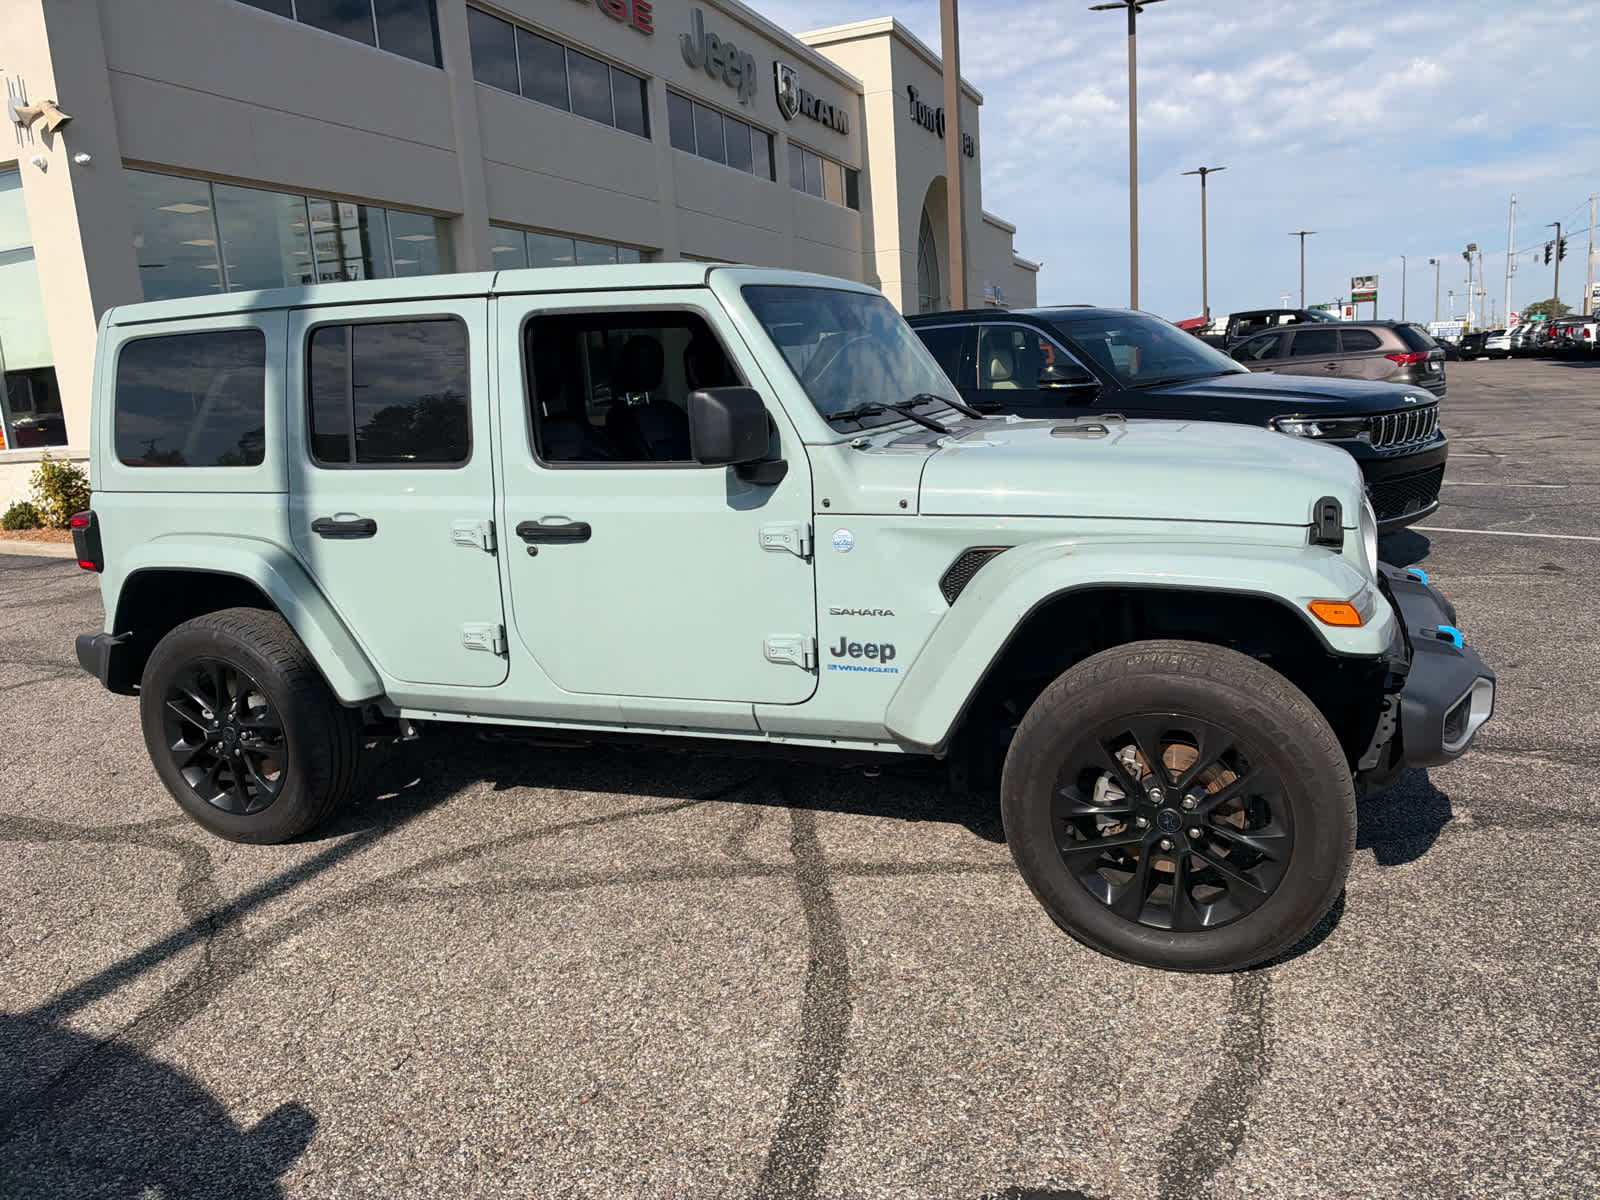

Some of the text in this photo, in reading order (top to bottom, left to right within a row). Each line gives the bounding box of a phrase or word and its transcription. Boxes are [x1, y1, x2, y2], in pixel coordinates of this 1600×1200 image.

[679, 7, 757, 105] Jeep
[798, 87, 849, 135] RAM
[906, 84, 935, 133] Tom
[828, 607, 895, 617] SAHARA
[829, 636, 897, 664] Jeep
[837, 664, 899, 674] WRANGLER
